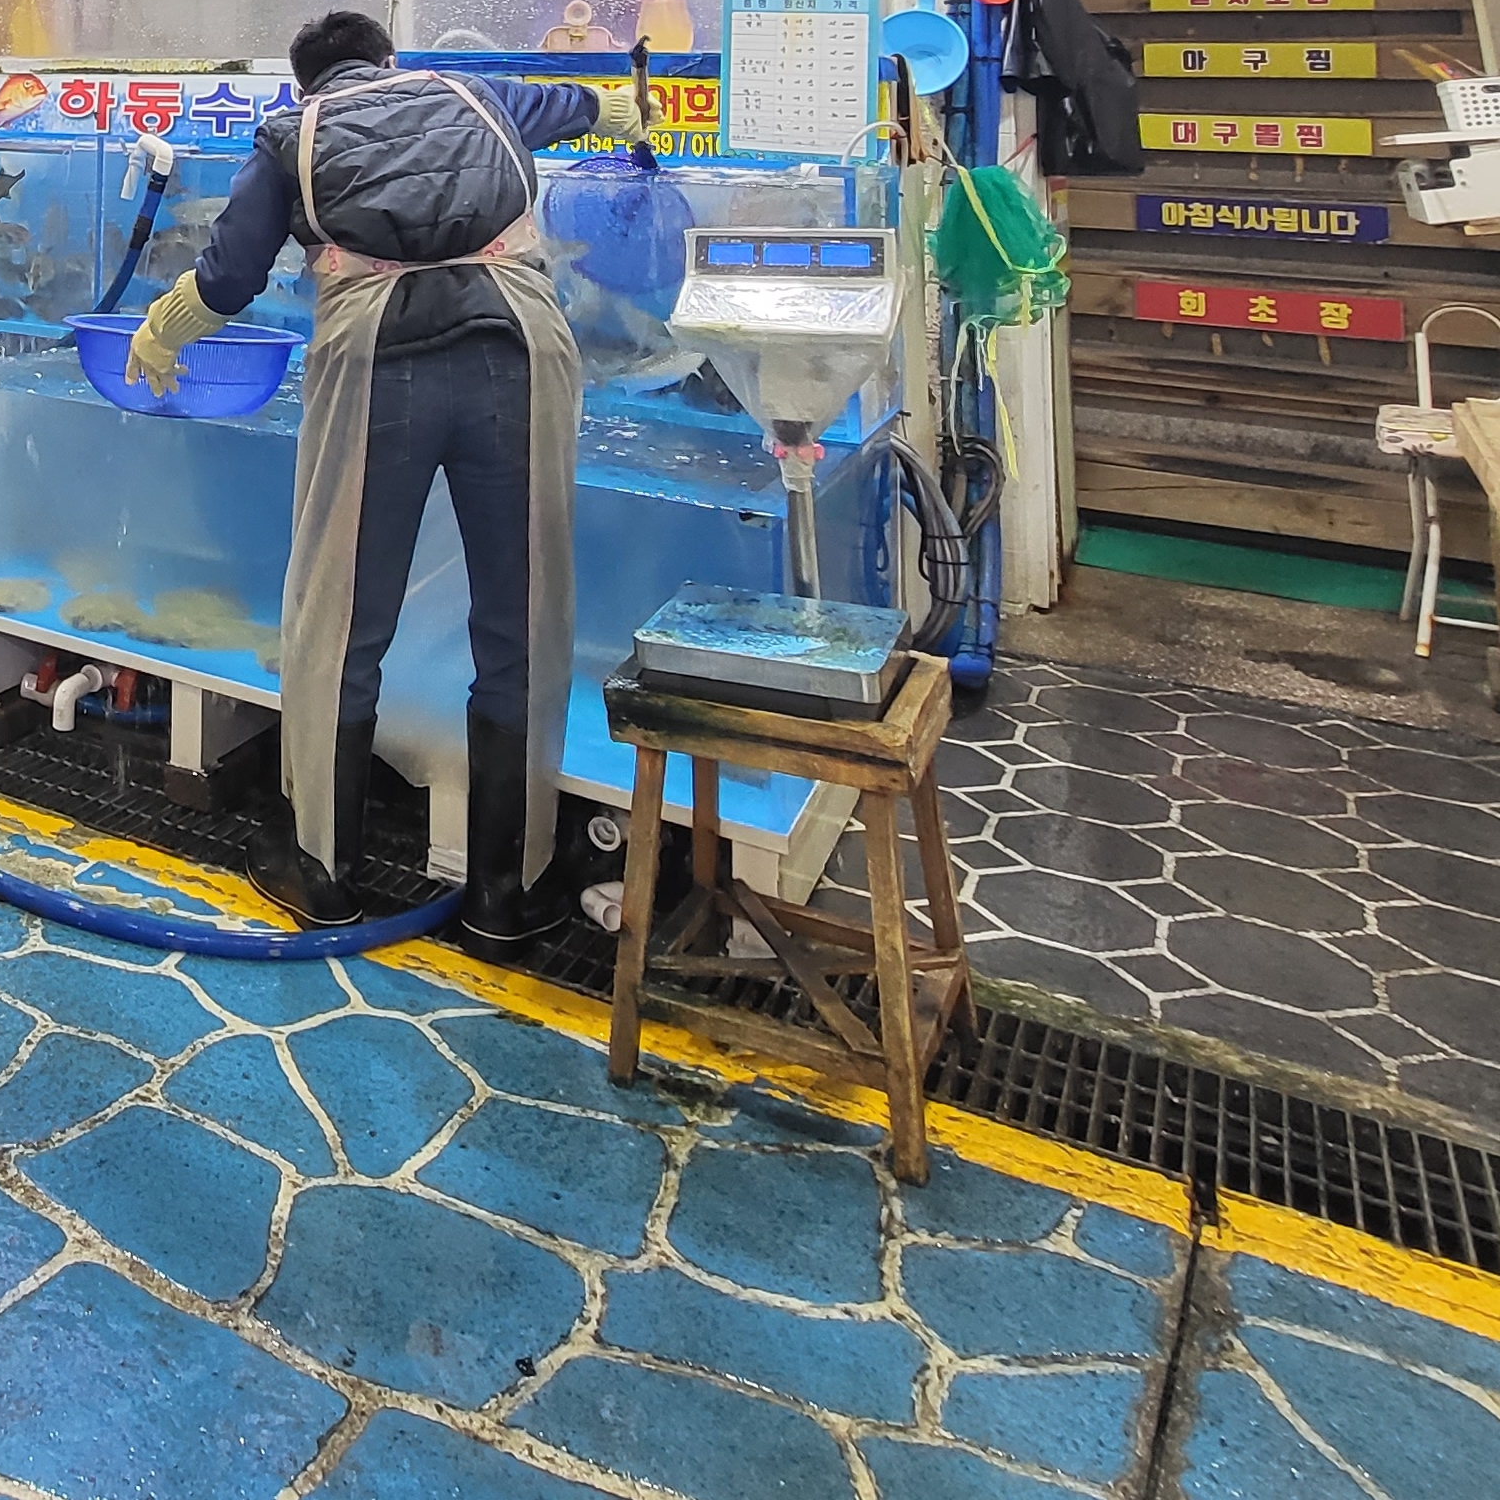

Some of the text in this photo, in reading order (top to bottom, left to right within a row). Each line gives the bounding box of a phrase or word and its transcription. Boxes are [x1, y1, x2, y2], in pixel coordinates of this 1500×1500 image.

[784, 0, 816, 9] 원산지
[833, 0, 858, 9] 가격
[1183, 48, 1333, 72] 아구찜
[1179, 290, 1353, 330] 회초장
